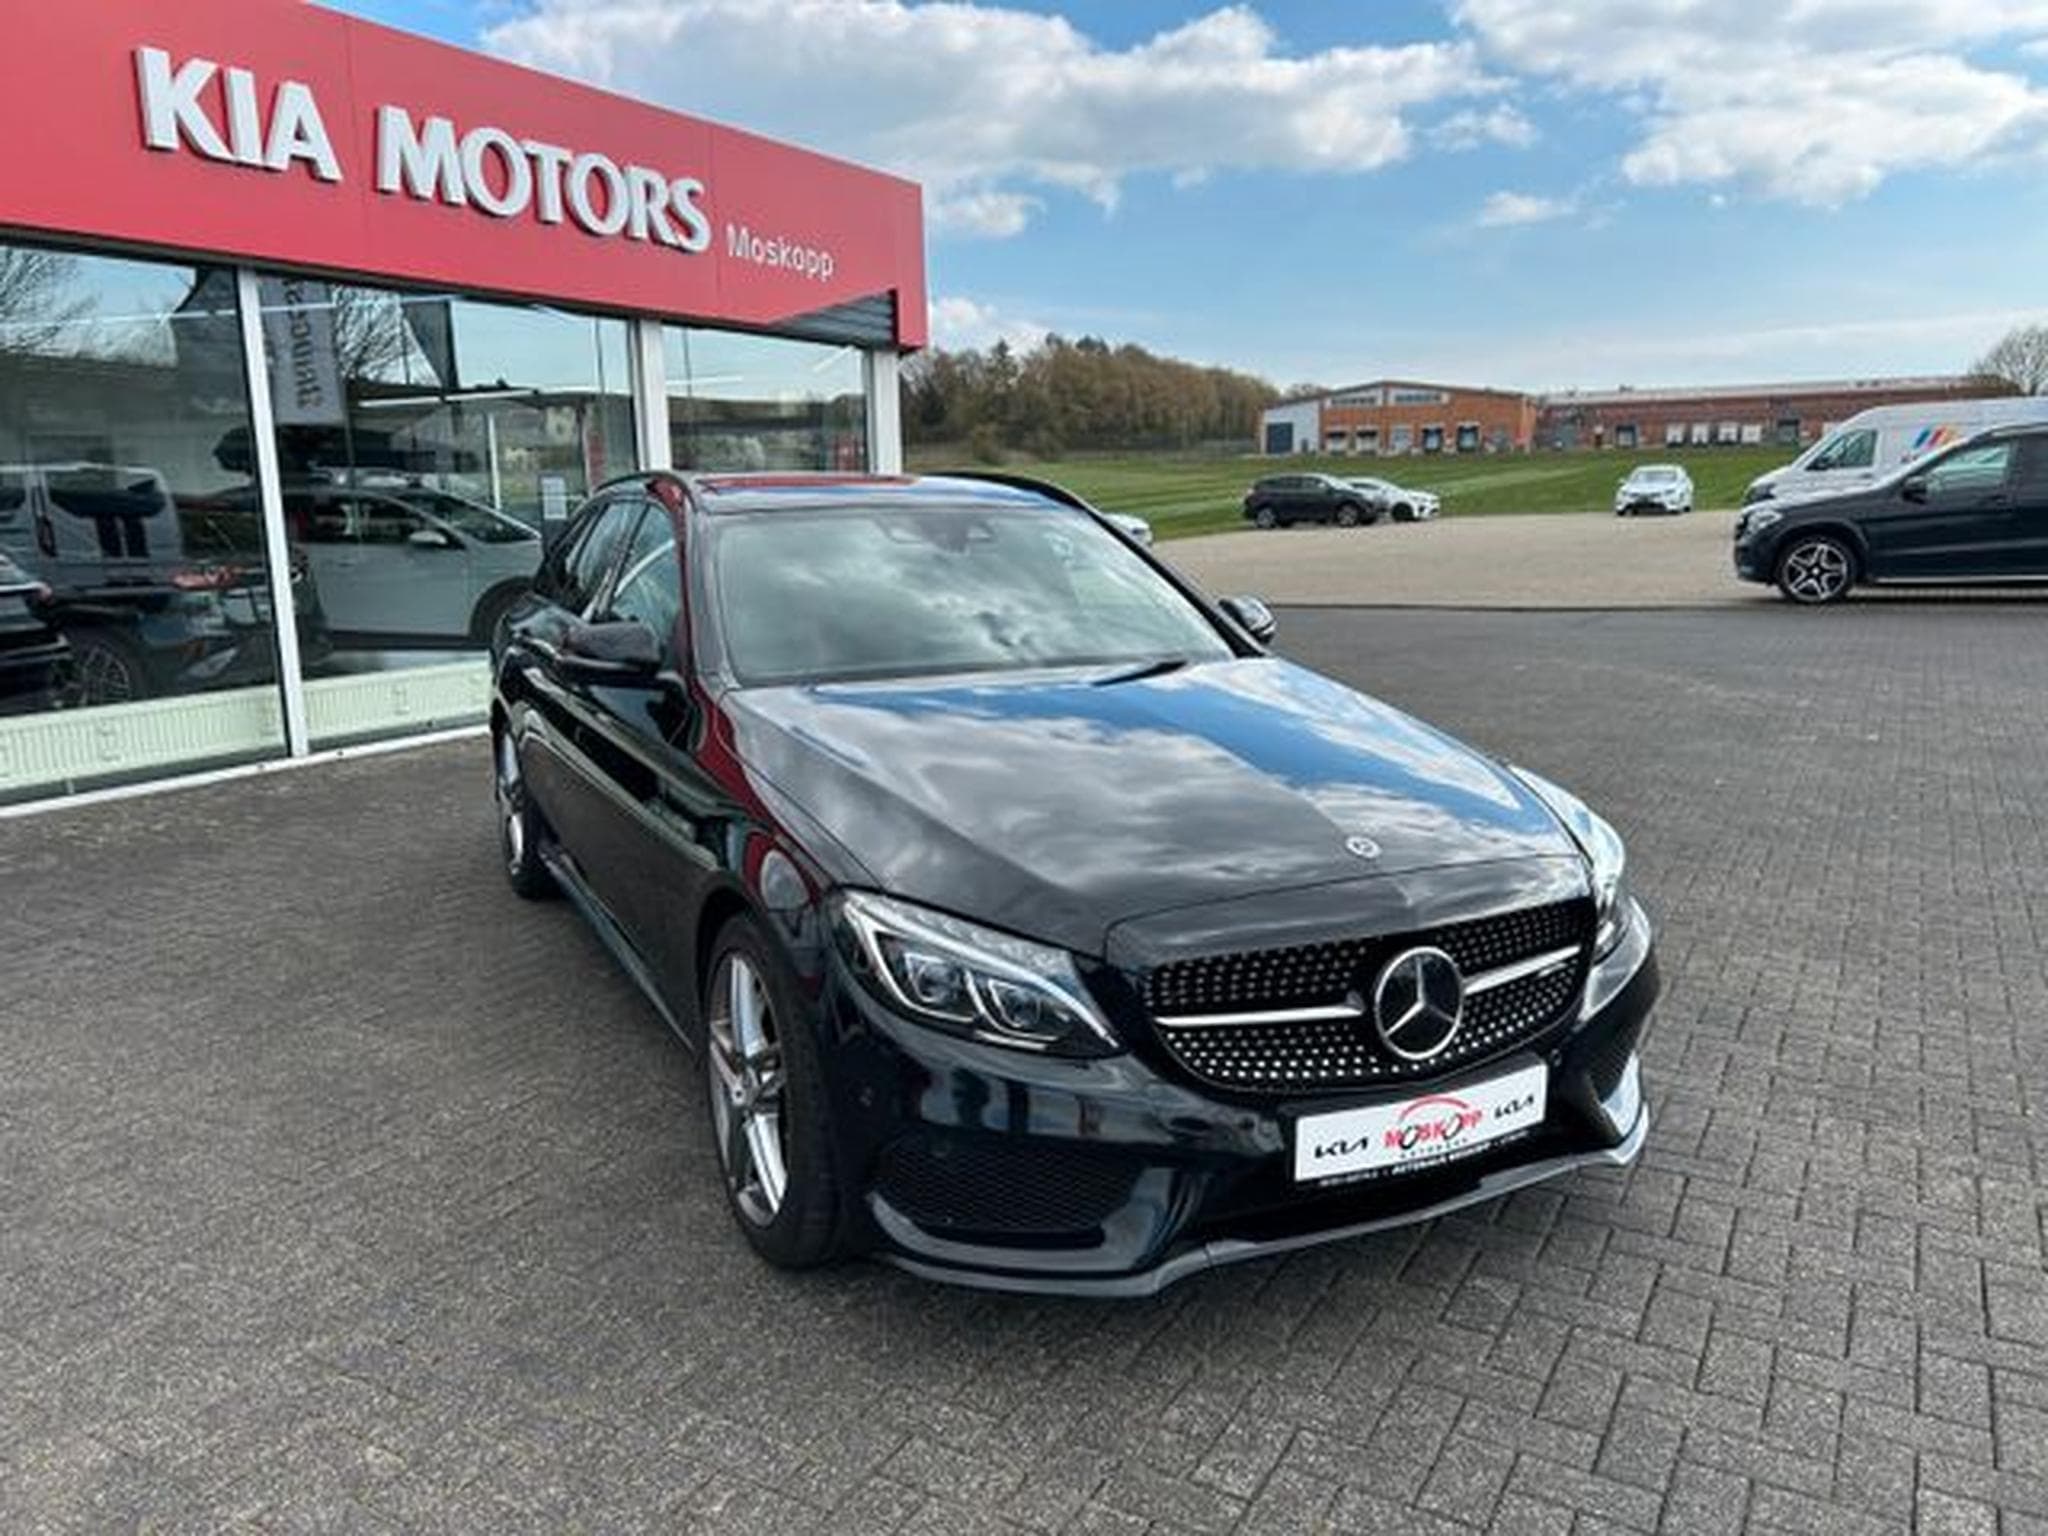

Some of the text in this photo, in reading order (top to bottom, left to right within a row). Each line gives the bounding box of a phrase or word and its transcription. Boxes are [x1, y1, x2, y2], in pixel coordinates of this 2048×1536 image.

[133, 46, 711, 254] KIA MOTORS
[725, 223, 834, 282] Moskopp
[1315, 1136, 1369, 1159] KIA
